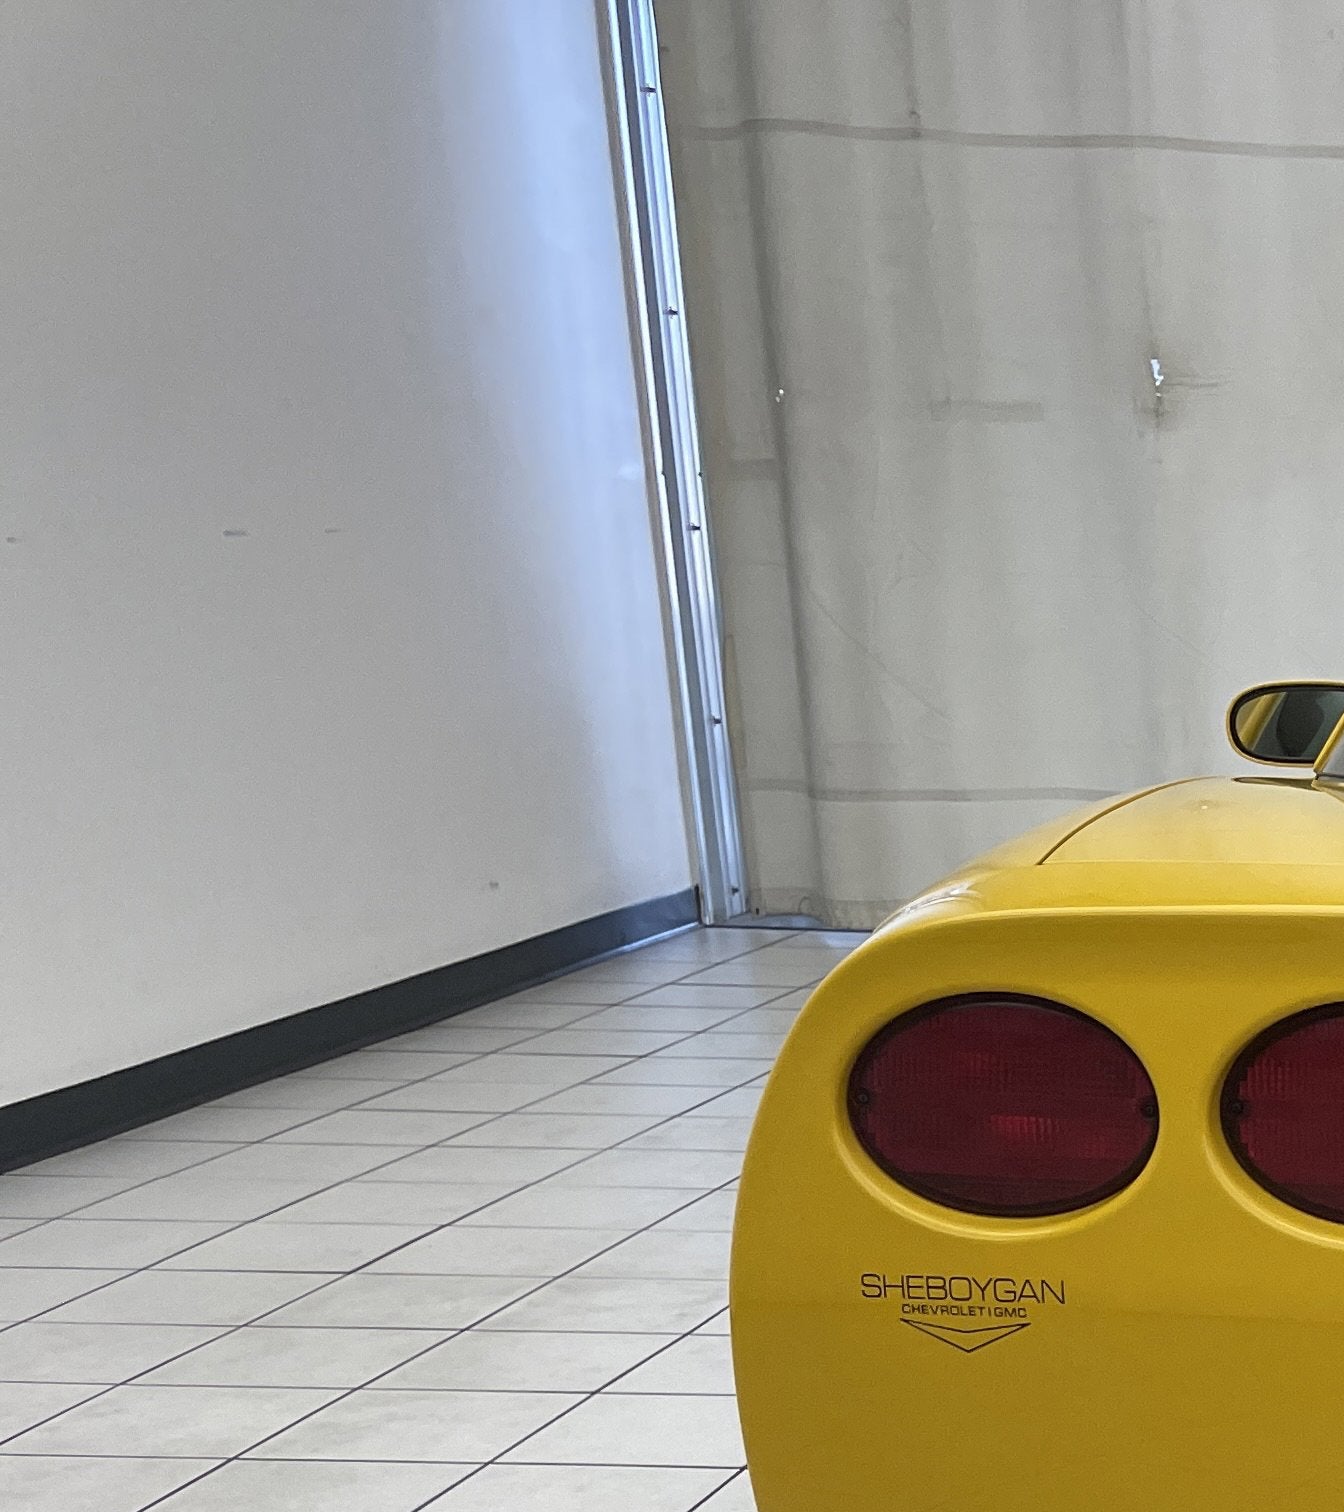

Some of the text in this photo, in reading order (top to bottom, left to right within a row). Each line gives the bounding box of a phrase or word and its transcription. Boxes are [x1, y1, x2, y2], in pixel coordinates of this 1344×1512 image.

[861, 1273, 1066, 1304] SHEBOYGAN
[901, 1303, 1028, 1318] CHEVROLET GMC
